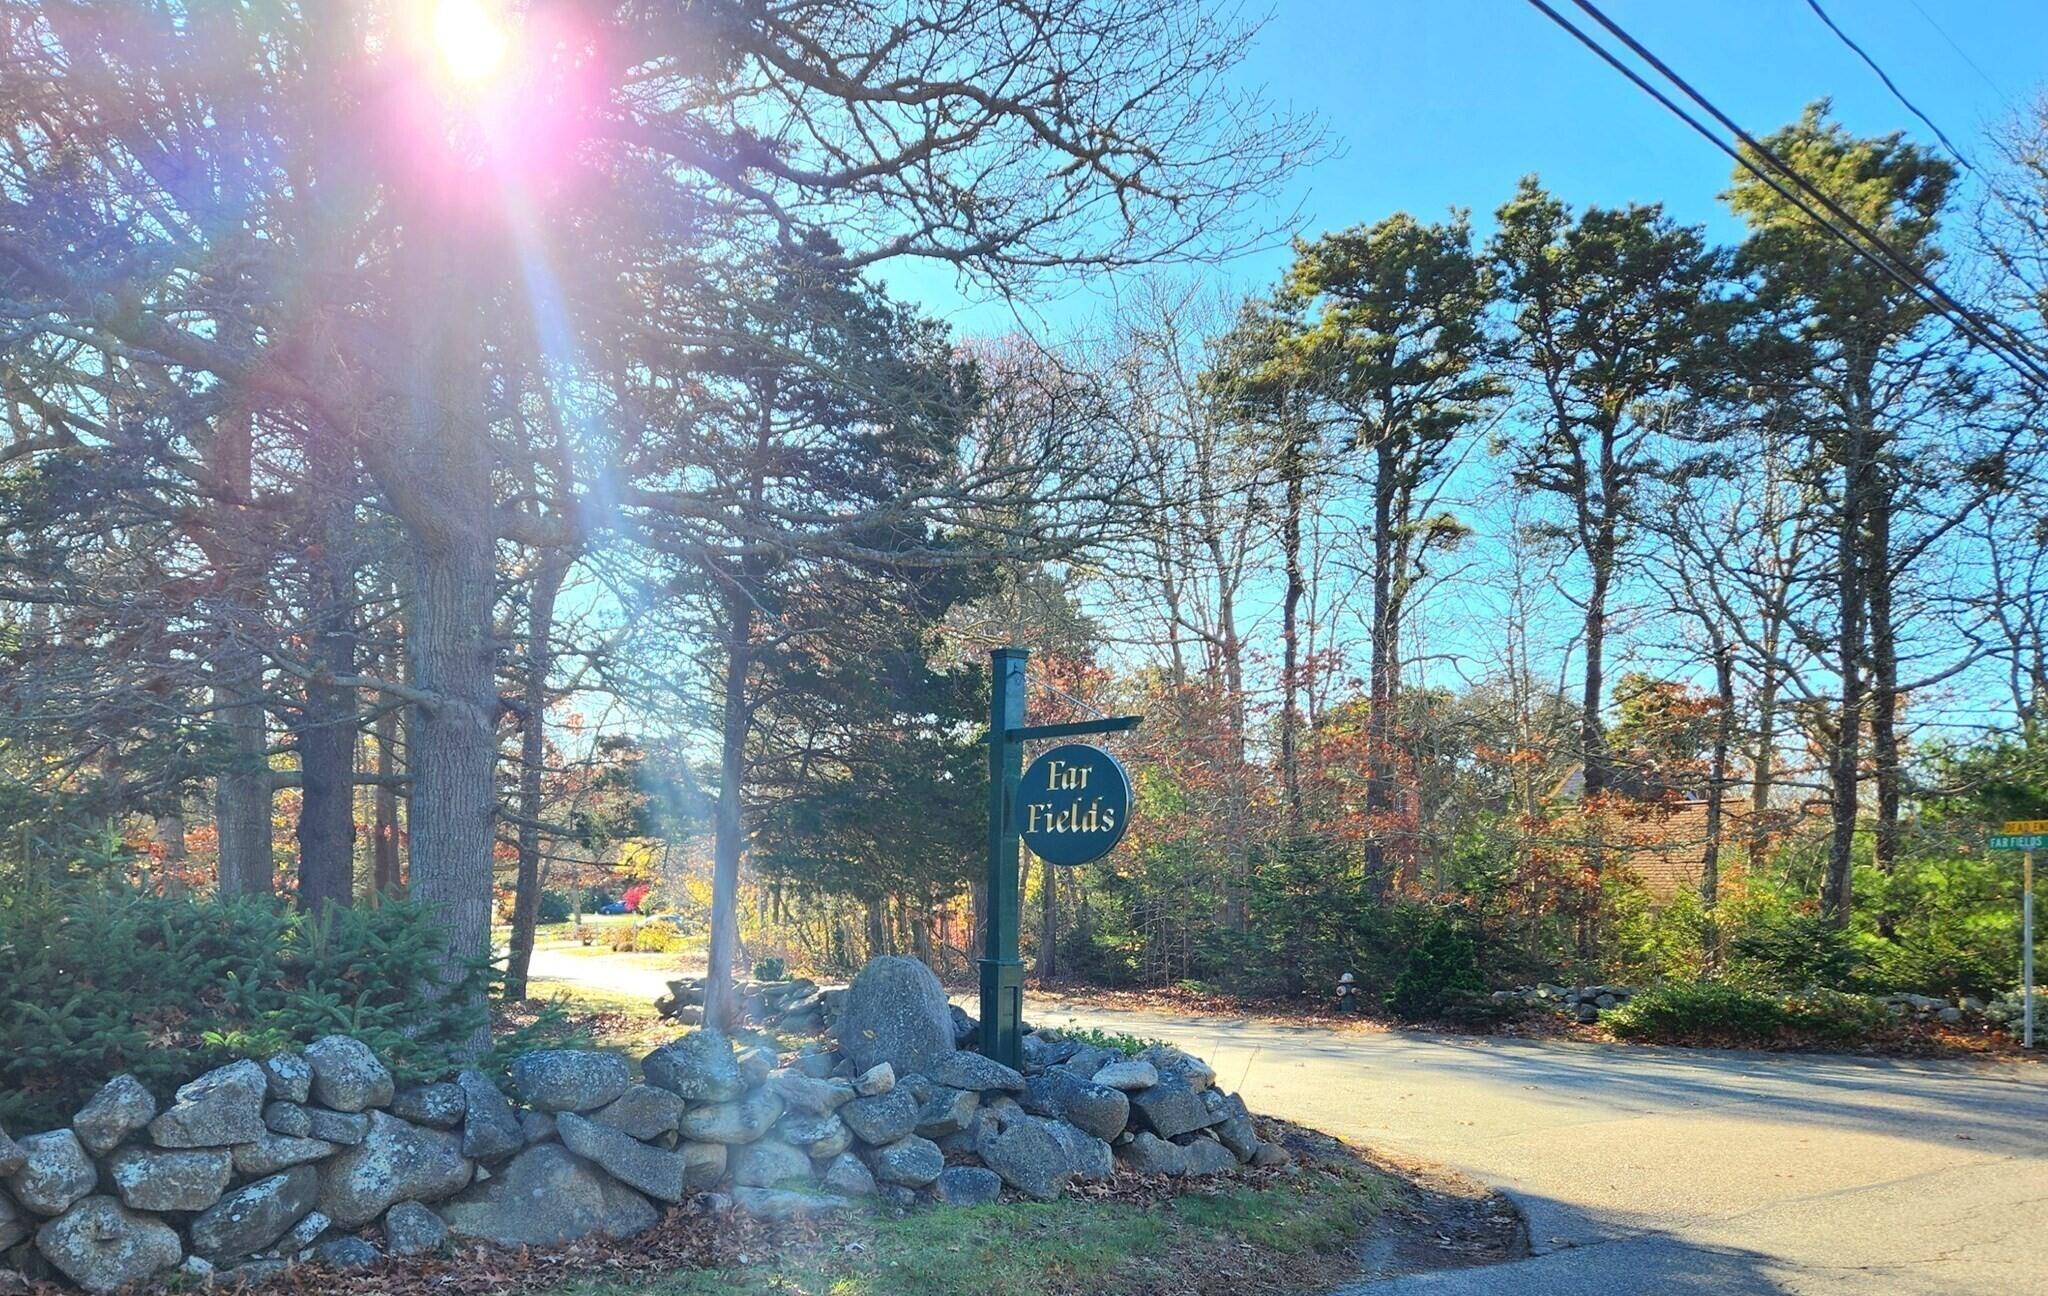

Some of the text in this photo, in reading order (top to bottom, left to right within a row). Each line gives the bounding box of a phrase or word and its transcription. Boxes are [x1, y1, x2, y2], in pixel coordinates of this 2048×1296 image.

[1046, 760, 1093, 791] Far
[1025, 796, 1114, 834] Fields
[1990, 836, 2042, 848] FAR FIELDS
